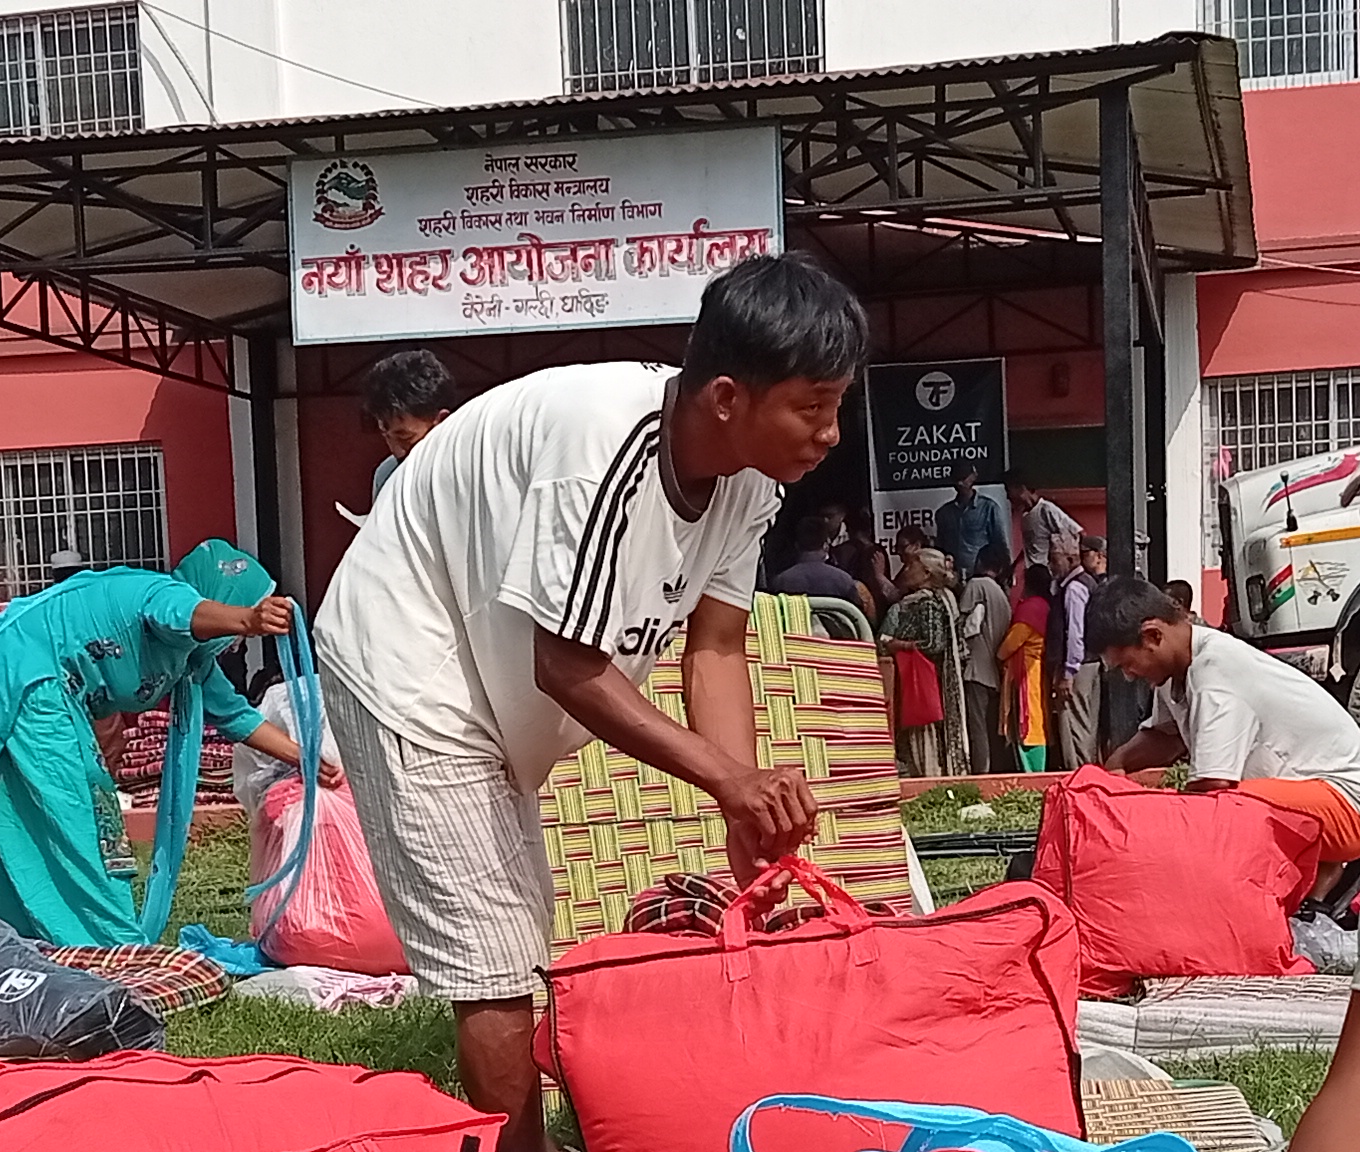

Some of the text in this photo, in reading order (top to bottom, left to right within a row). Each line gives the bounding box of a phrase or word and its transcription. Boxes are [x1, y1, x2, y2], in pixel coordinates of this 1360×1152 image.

[484, 153, 578, 173] नेपाल सरकार
[464, 176, 610, 205] शहरी विकास मन्त्रालय
[417, 199, 662, 237] शहरी विकास तथा भवन निर्माण विभाग
[373, 249, 451, 295] शहर
[459, 232, 617, 287] आयोजना
[897, 422, 981, 446] ZAKAT
[889, 446, 988, 463] FOUNDATION
[893, 466, 952, 481] of AMER
